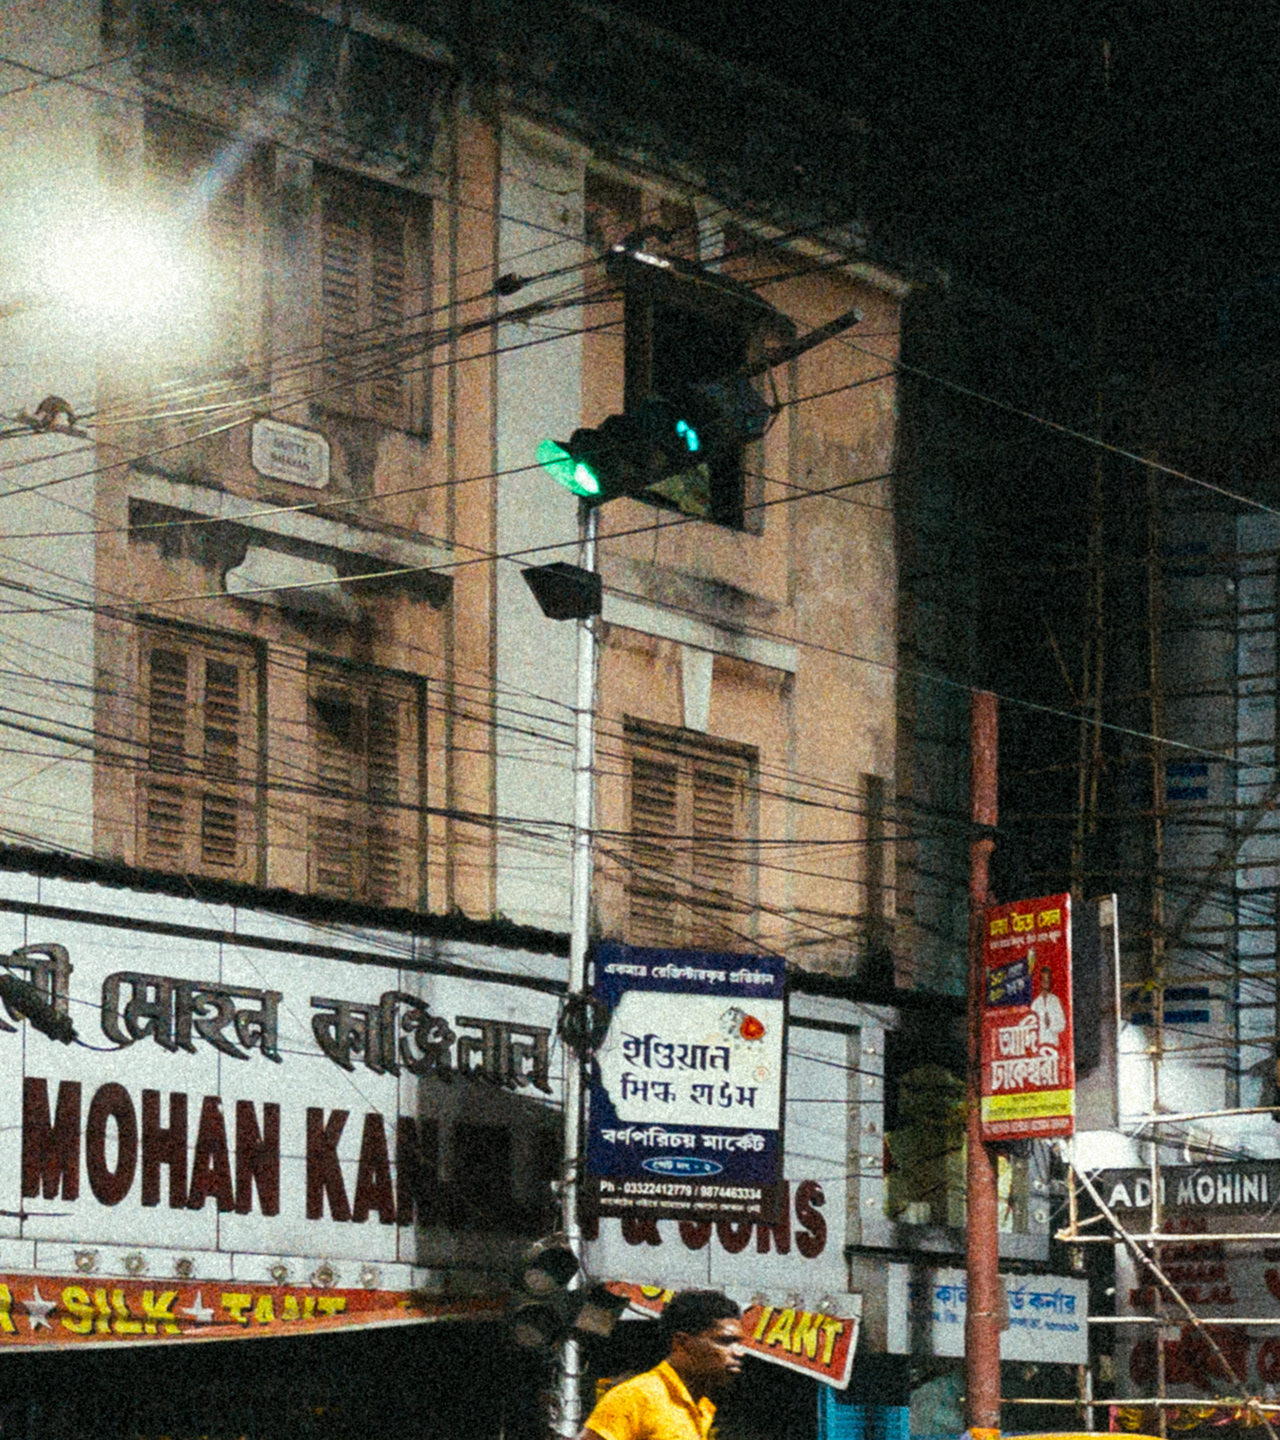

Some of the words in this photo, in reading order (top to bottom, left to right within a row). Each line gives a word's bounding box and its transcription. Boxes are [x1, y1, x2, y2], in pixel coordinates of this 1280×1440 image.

[999, 1015, 1037, 1056] আদি
[21, 1077, 281, 1217] MOHAN
[600, 1181, 615, 1193] Ph
[1177, 1173, 1269, 1205] MOHINI
[61, 1285, 183, 1335] SILK
